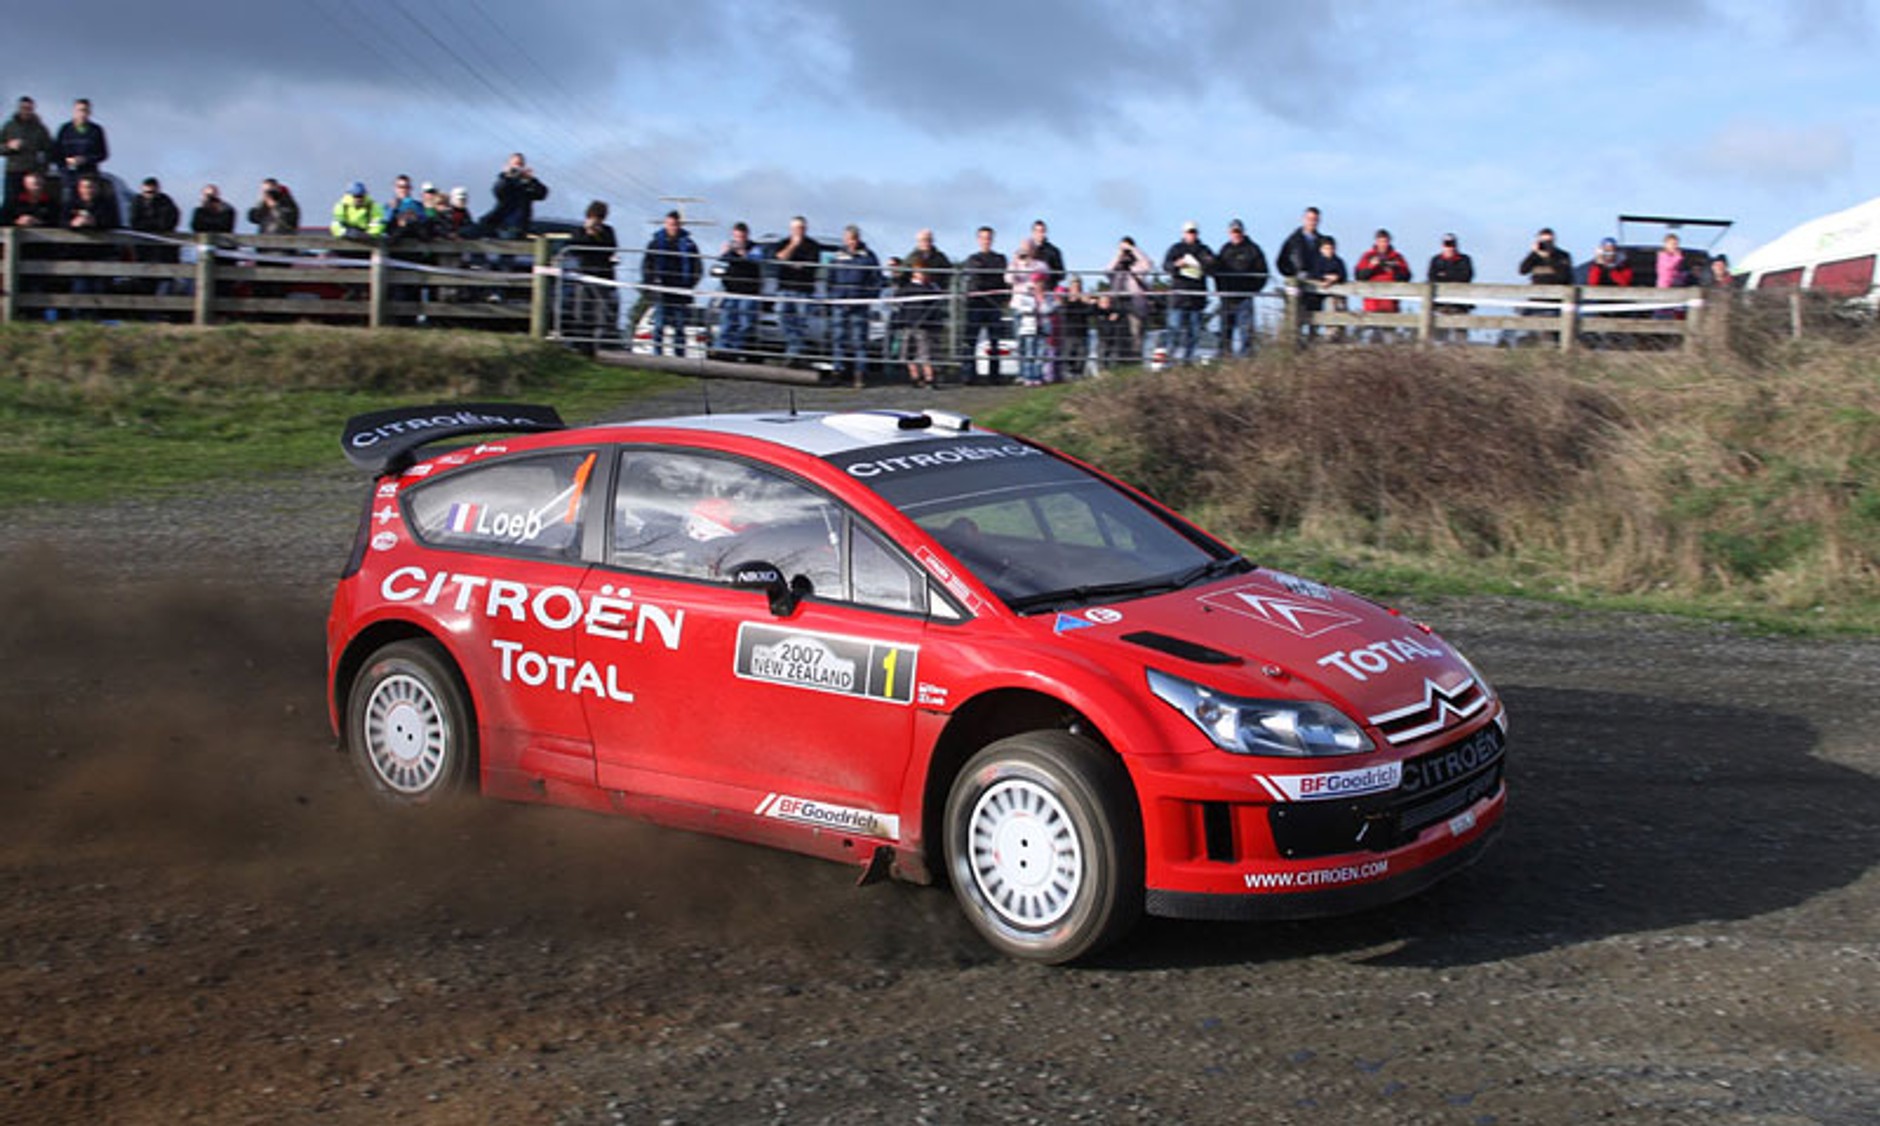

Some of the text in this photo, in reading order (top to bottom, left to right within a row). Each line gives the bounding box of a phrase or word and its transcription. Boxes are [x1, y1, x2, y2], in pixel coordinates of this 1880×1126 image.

[476, 502, 541, 541] Loeb
[381, 566, 685, 650] CITROËN
[780, 644, 823, 665] 2007
[753, 658, 852, 688] NEW ZEALAND
[883, 648, 898, 698] 1
[1300, 766, 1398, 794] BFGoodrich
[1244, 860, 1388, 888] WWW.CITROEN.COM
